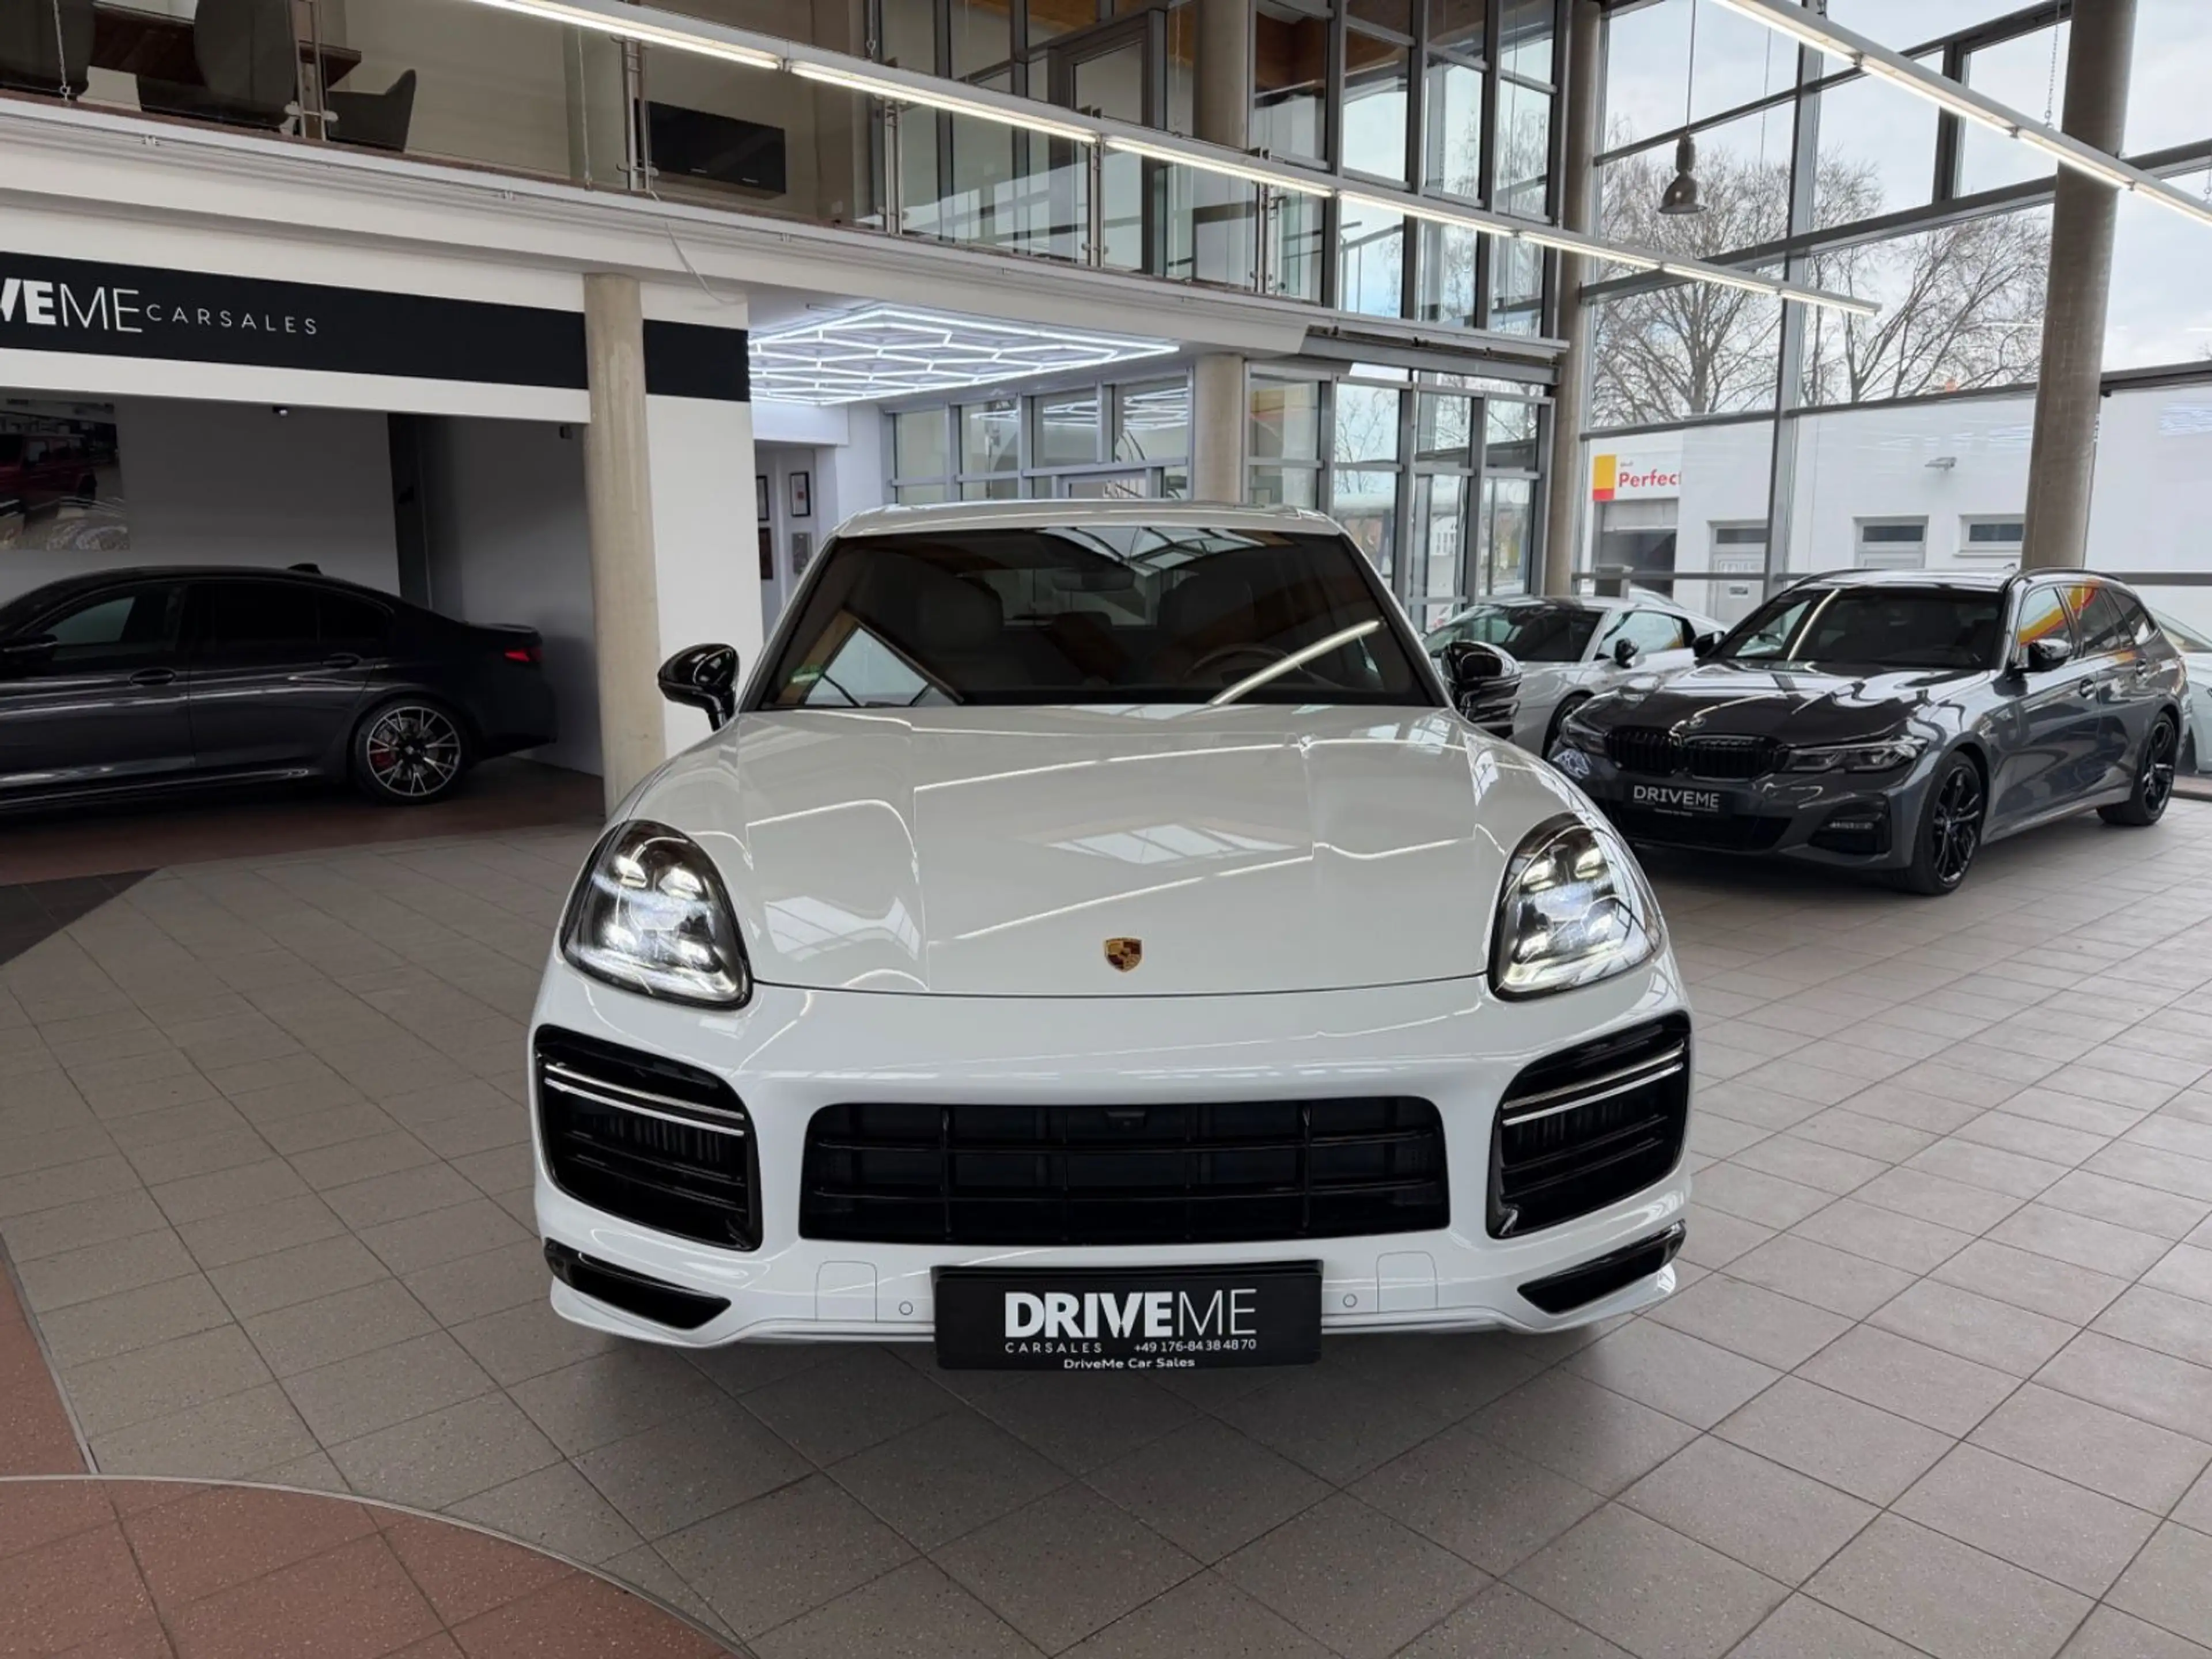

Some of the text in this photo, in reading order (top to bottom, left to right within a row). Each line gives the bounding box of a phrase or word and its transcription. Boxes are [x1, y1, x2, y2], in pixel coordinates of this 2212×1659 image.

[146, 304, 317, 335] CARSALES
[1633, 785, 1719, 808] DRIVEME
[1005, 1289, 1257, 1338] DRIVEME
[1004, 1342, 1102, 1354] CARSALES
[1134, 1341, 1158, 1353] +49
[1063, 1357, 1196, 1369] DriveMe Car Sales
